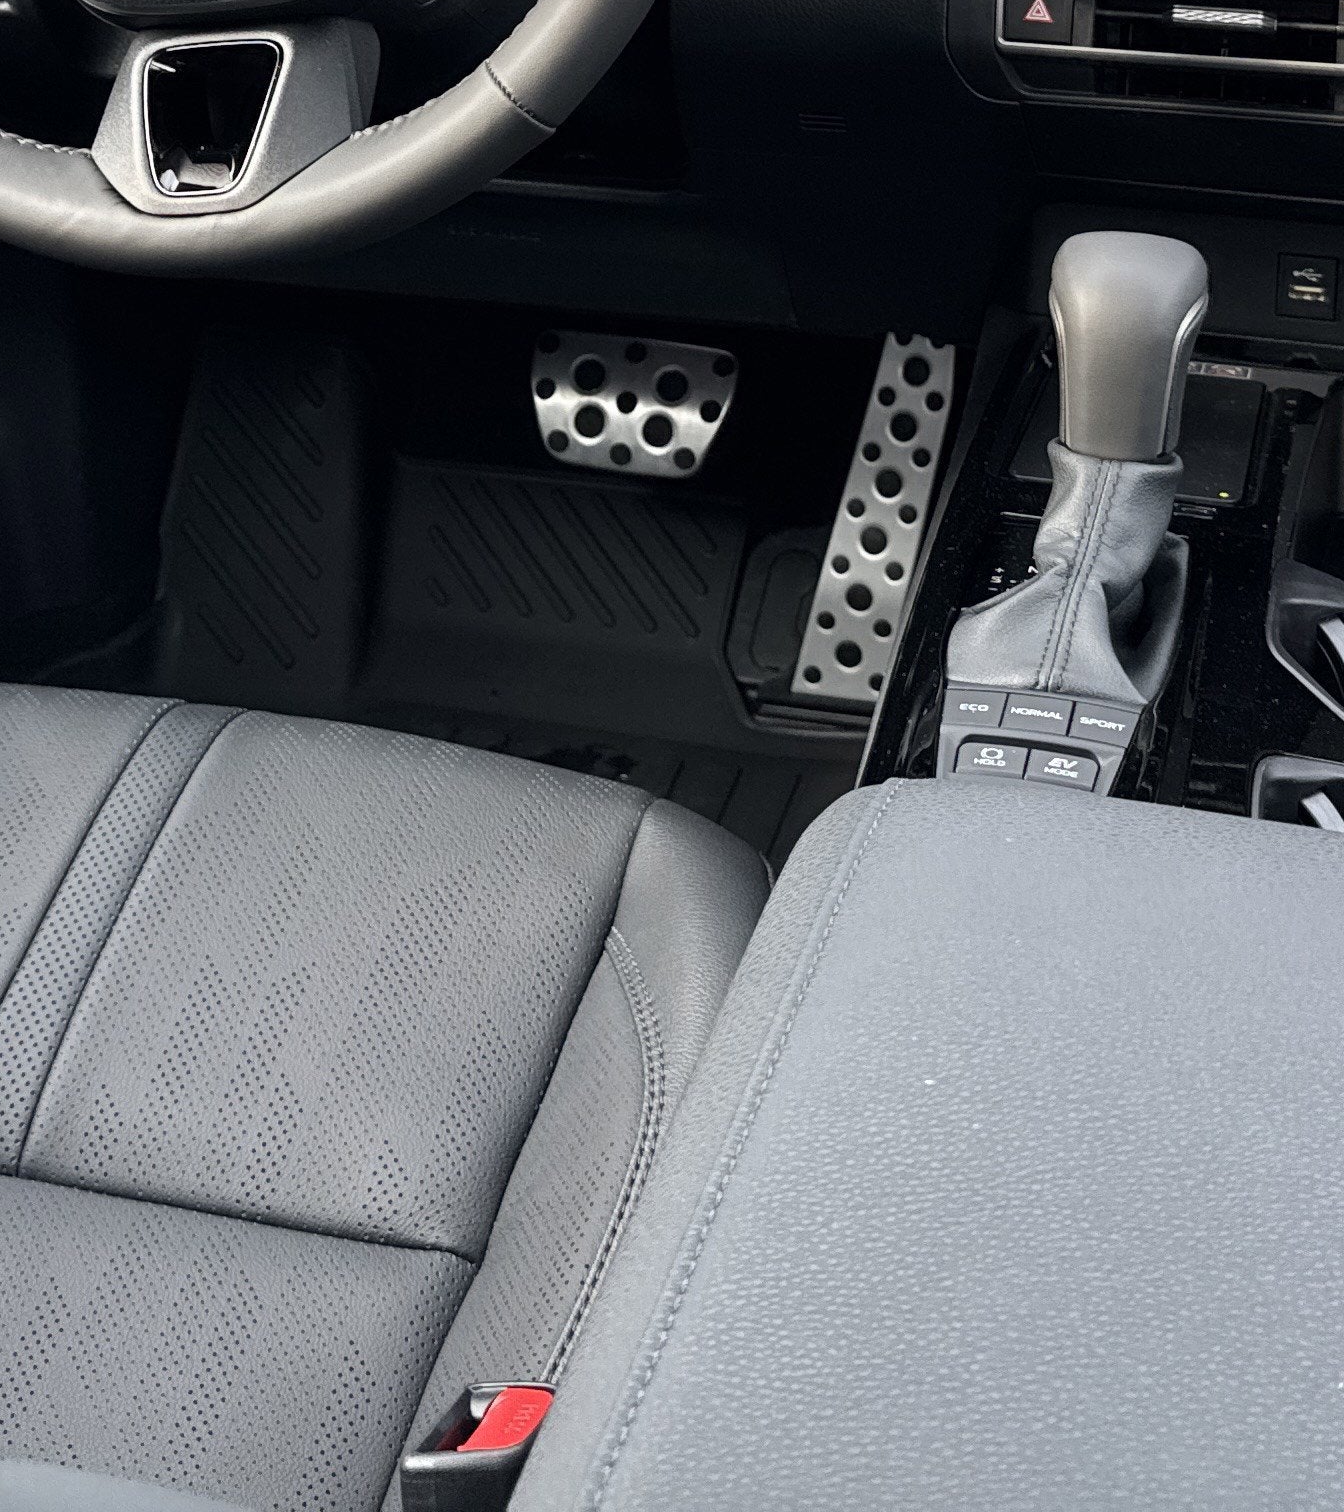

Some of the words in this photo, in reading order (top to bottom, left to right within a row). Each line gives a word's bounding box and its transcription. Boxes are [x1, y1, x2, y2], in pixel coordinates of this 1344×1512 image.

[959, 703, 989, 713] ECO
[1010, 706, 1063, 720] NORMAL
[1079, 716, 1126, 732] SPORT
[973, 757, 1006, 767] HOLD
[1047, 757, 1079, 768] EV
[1043, 766, 1079, 778] MODE
